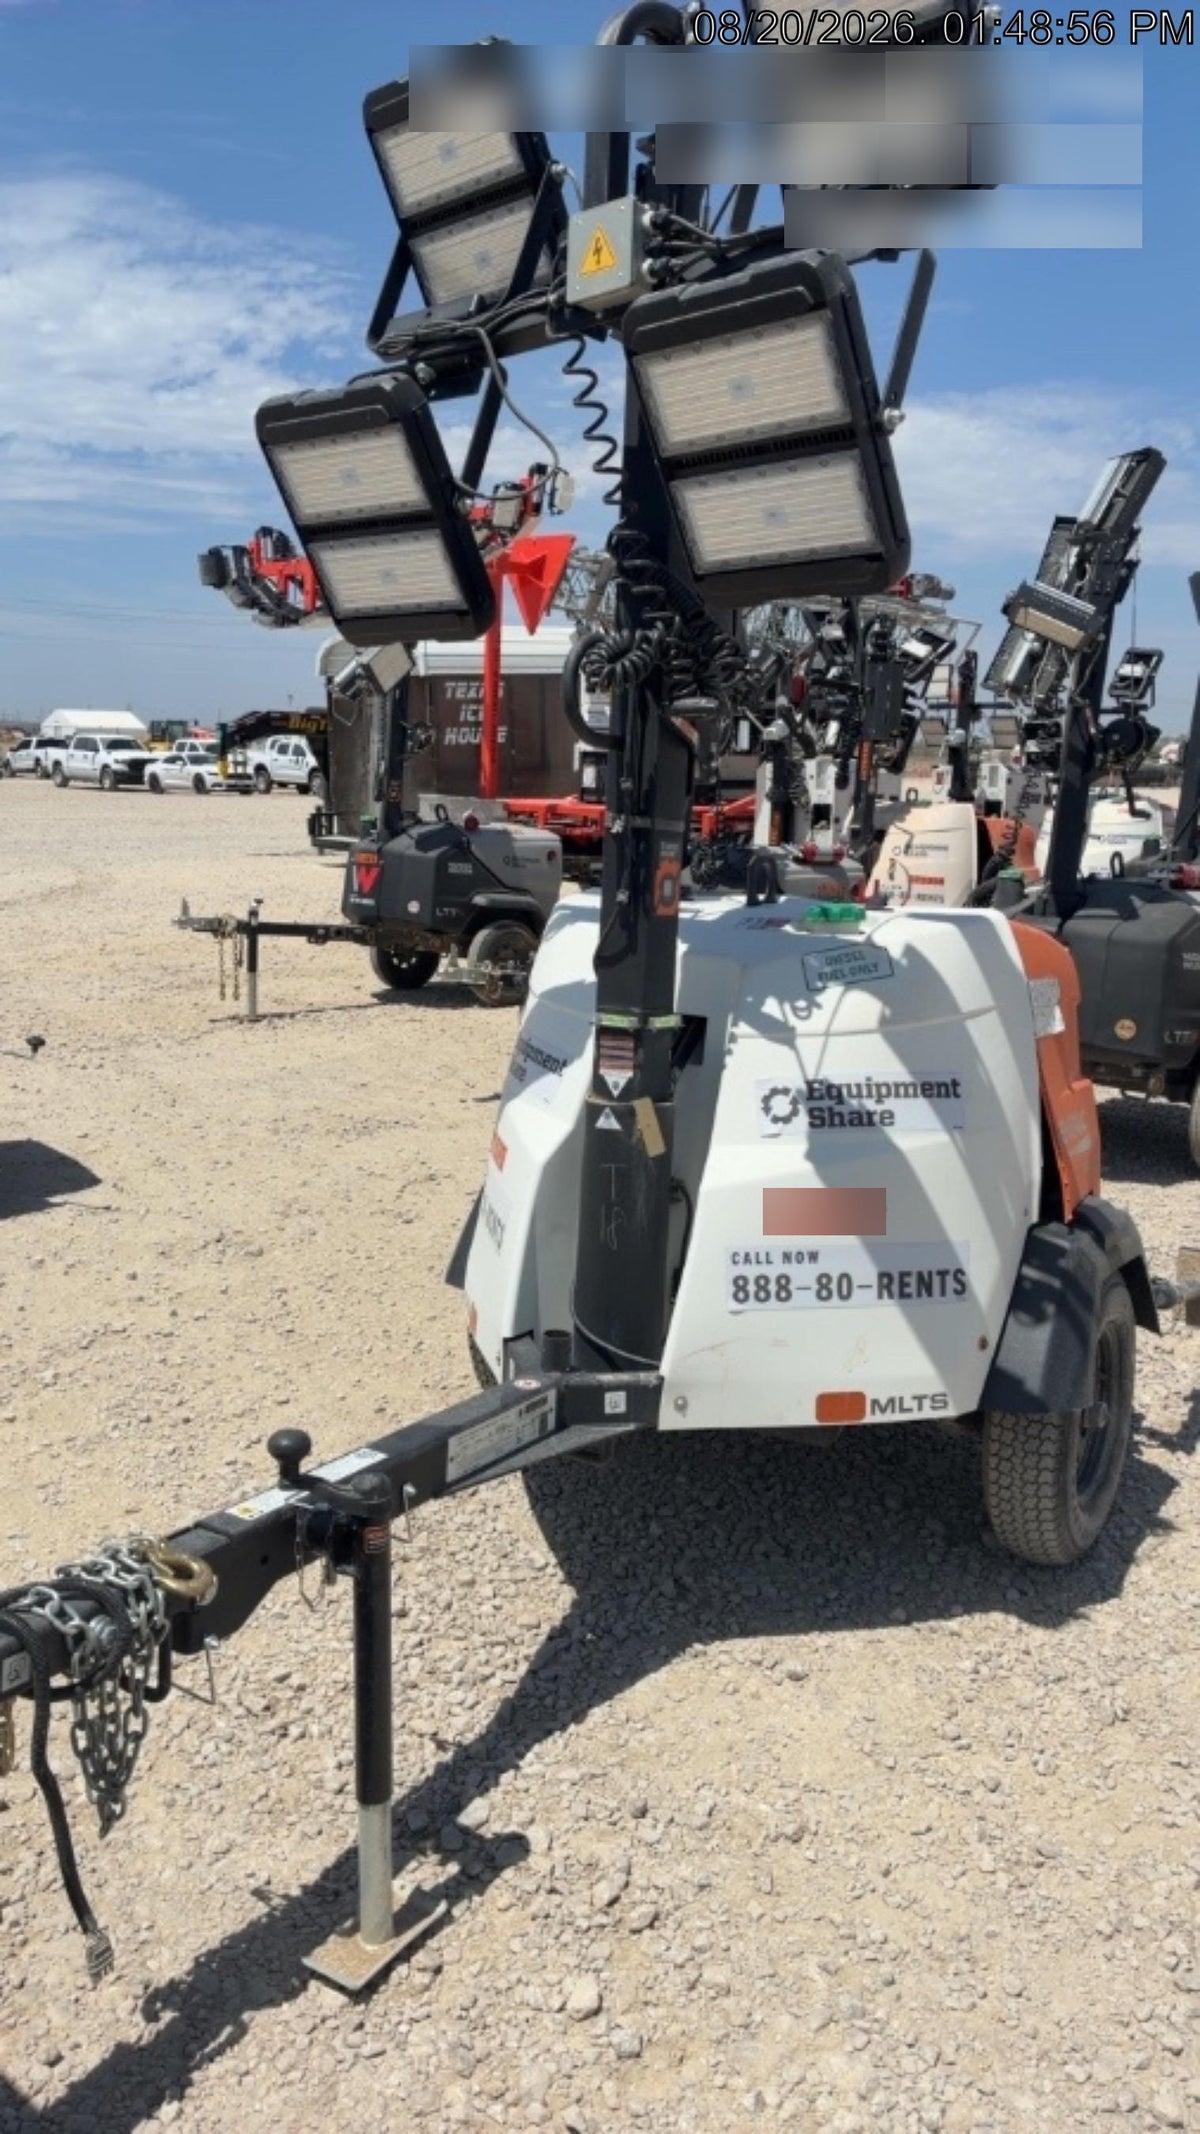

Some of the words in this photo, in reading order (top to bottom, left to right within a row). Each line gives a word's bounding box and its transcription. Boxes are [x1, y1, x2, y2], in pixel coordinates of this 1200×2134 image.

[444, 727, 508, 745] HOUE
[806, 1077, 961, 1105] Equipment
[808, 1107, 895, 1129] Share
[731, 1251, 774, 1266] CALL
[782, 1251, 820, 1265] NOW
[732, 1268, 968, 1304] 888-80-RENTS
[869, 1393, 949, 1417] MLTS
